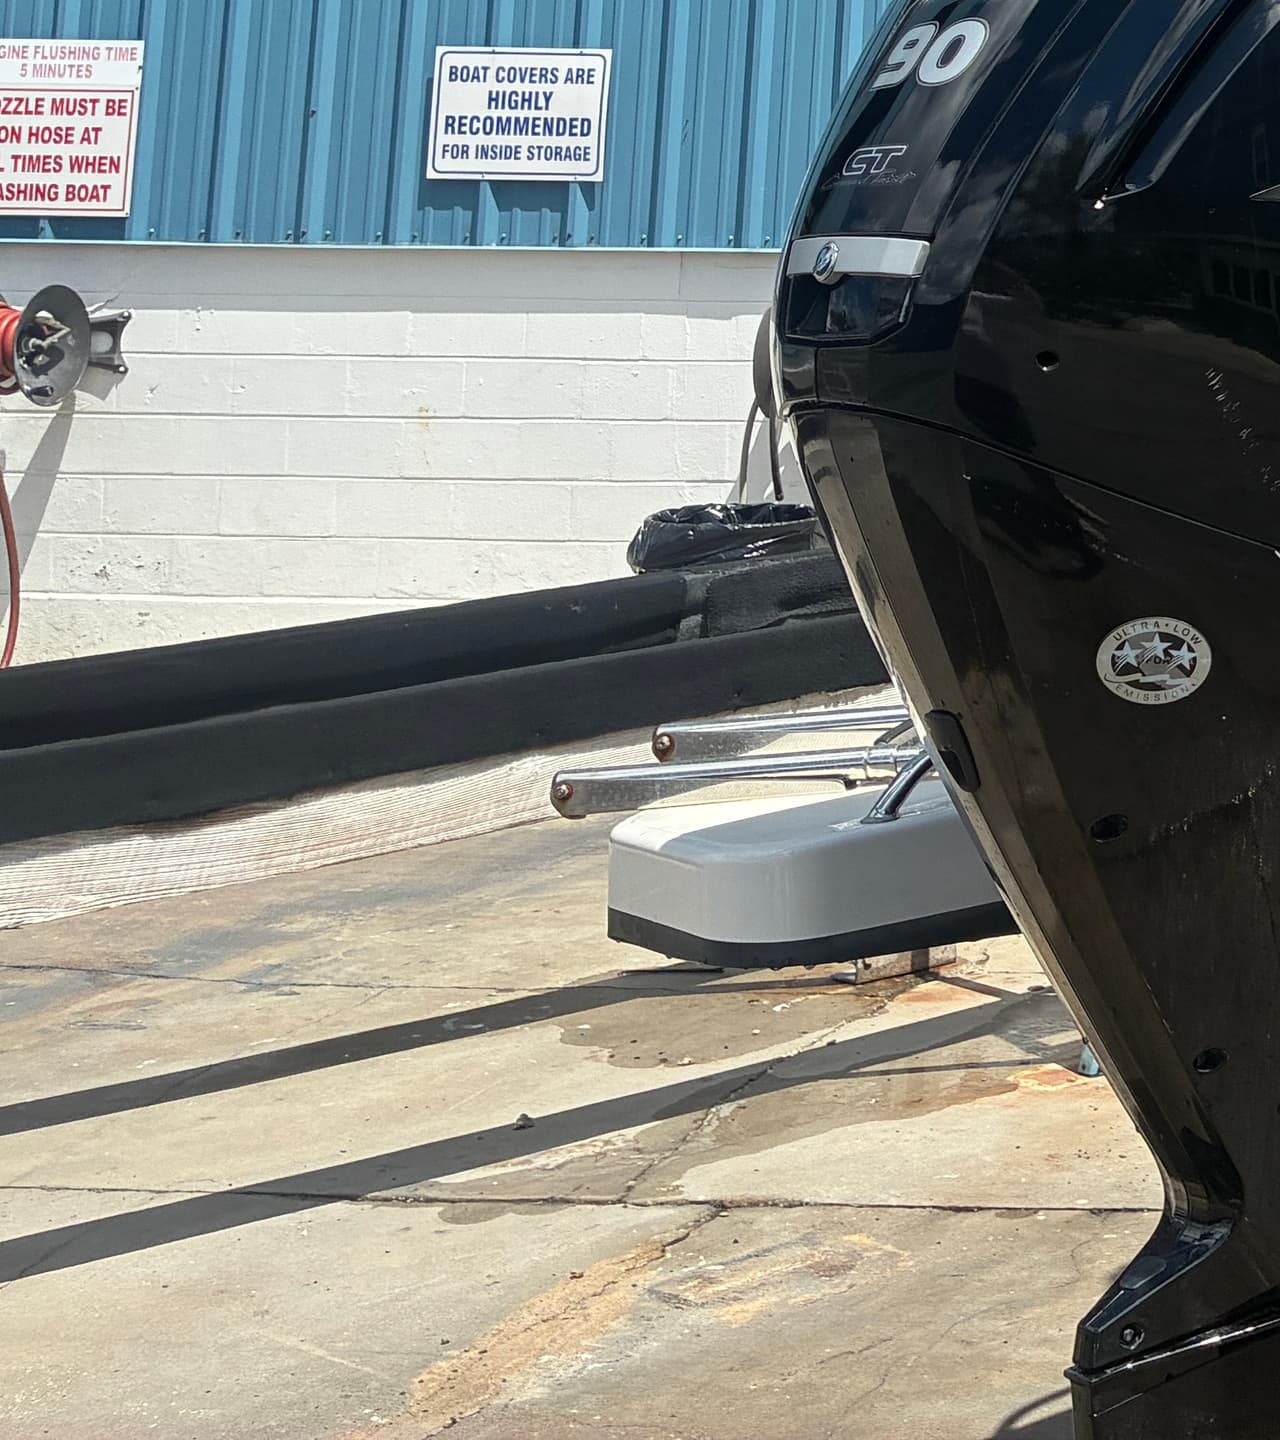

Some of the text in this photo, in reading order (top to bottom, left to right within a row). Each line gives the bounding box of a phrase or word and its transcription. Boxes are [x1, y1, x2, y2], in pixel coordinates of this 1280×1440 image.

[0, 45, 138, 61] GINE FLUSHING TIME
[869, 16, 990, 92] 90
[20, 63, 93, 78] 5 MINUTES
[448, 65, 596, 85] BOAT COVERS ARE
[0, 97, 128, 116] ZZLE MUST BE
[487, 90, 554, 111] HIGHLY
[0, 126, 102, 145] ON HOSE AT
[444, 115, 592, 137] RECOMMENDED
[441, 144, 591, 161] FOR INSIDE STORAGE
[11, 154, 63, 173] TIMES
[69, 155, 121, 174] WHEN
[0, 183, 112, 202] SHING BOAT
[1113, 620, 1203, 645] ULTRA LOW
[1115, 684, 1190, 702] EMISSION
